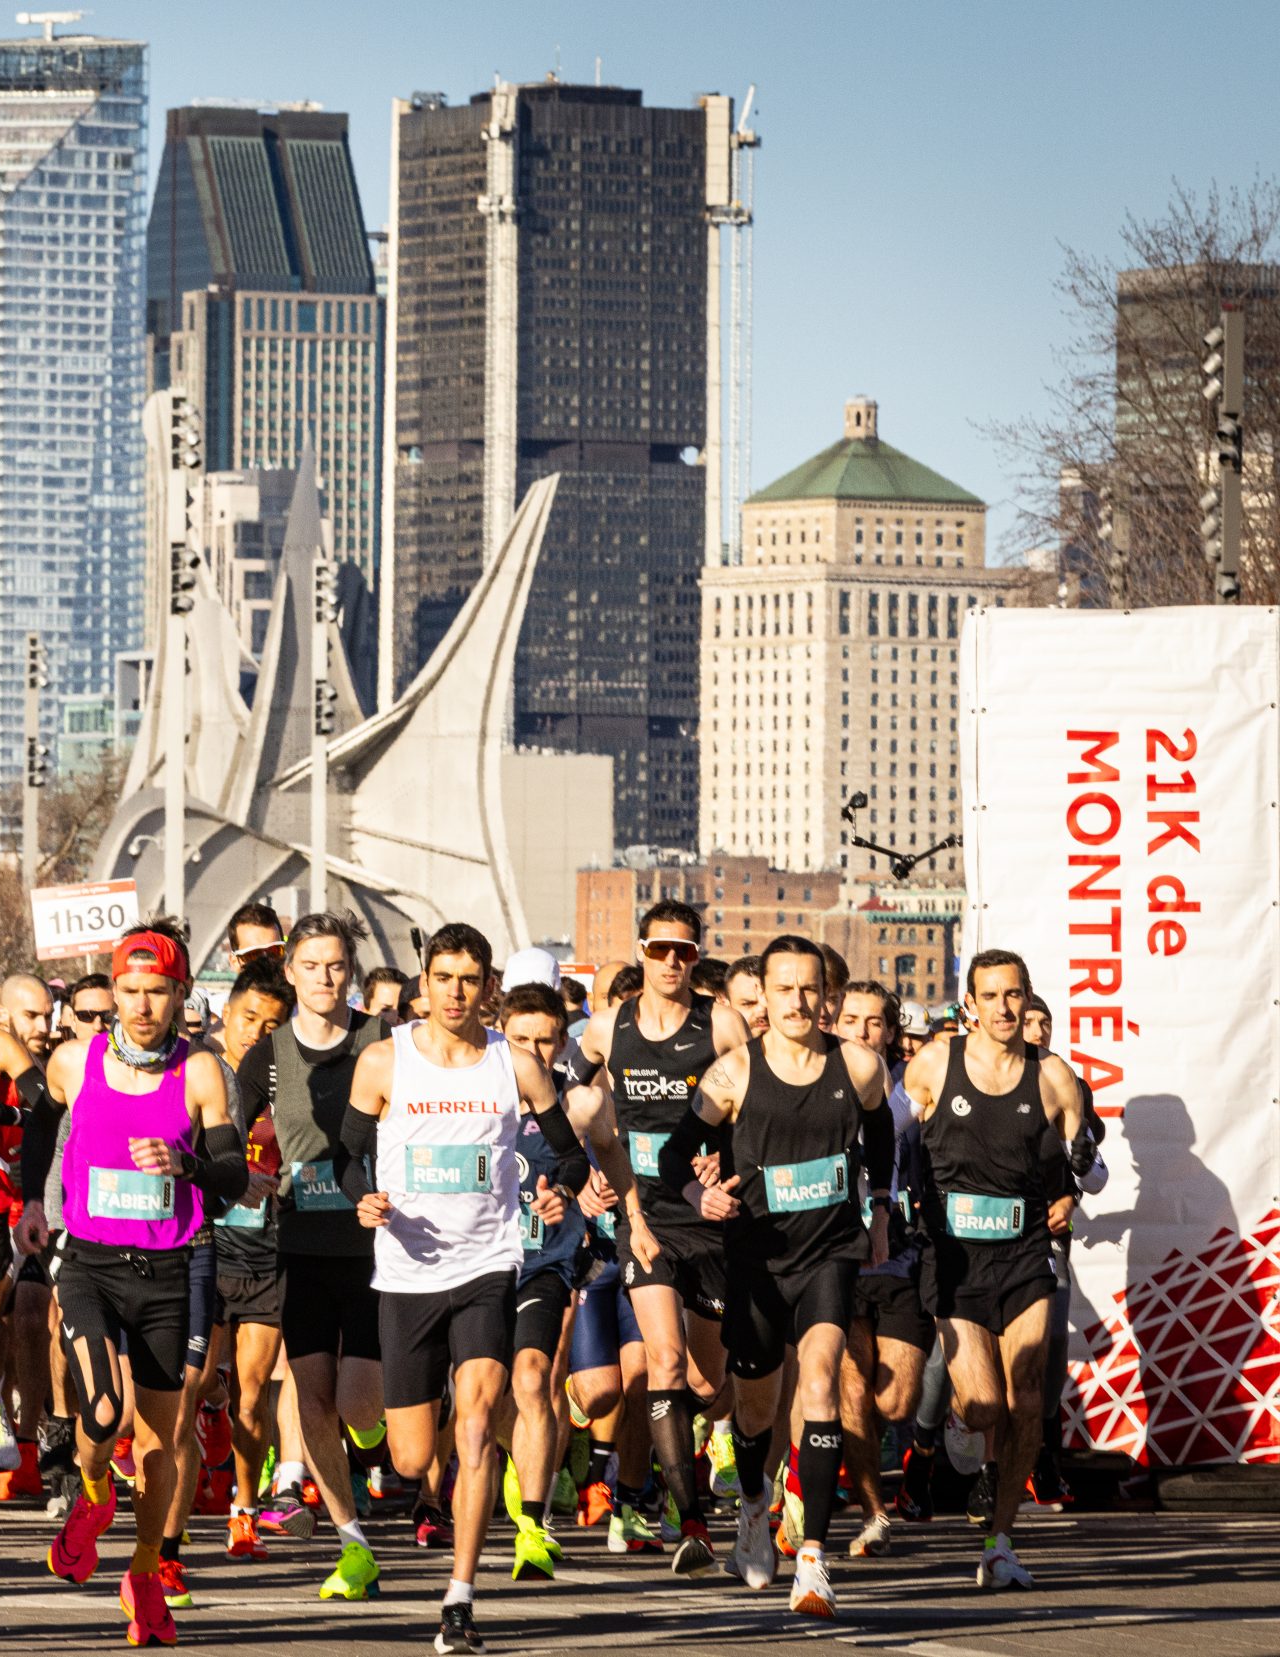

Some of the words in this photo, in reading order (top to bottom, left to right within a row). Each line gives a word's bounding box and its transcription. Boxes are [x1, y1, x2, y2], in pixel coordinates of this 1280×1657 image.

[1146, 727, 1201, 856] 21K
[49, 904, 125, 934] 1h30
[1146, 874, 1201, 957] de
[407, 1101, 504, 1115] MERRELL
[413, 1167, 461, 1184] REMI
[98, 1190, 161, 1210] FABIEN
[775, 1181, 836, 1203] MARCEL
[954, 1214, 1008, 1231] BRIAN
